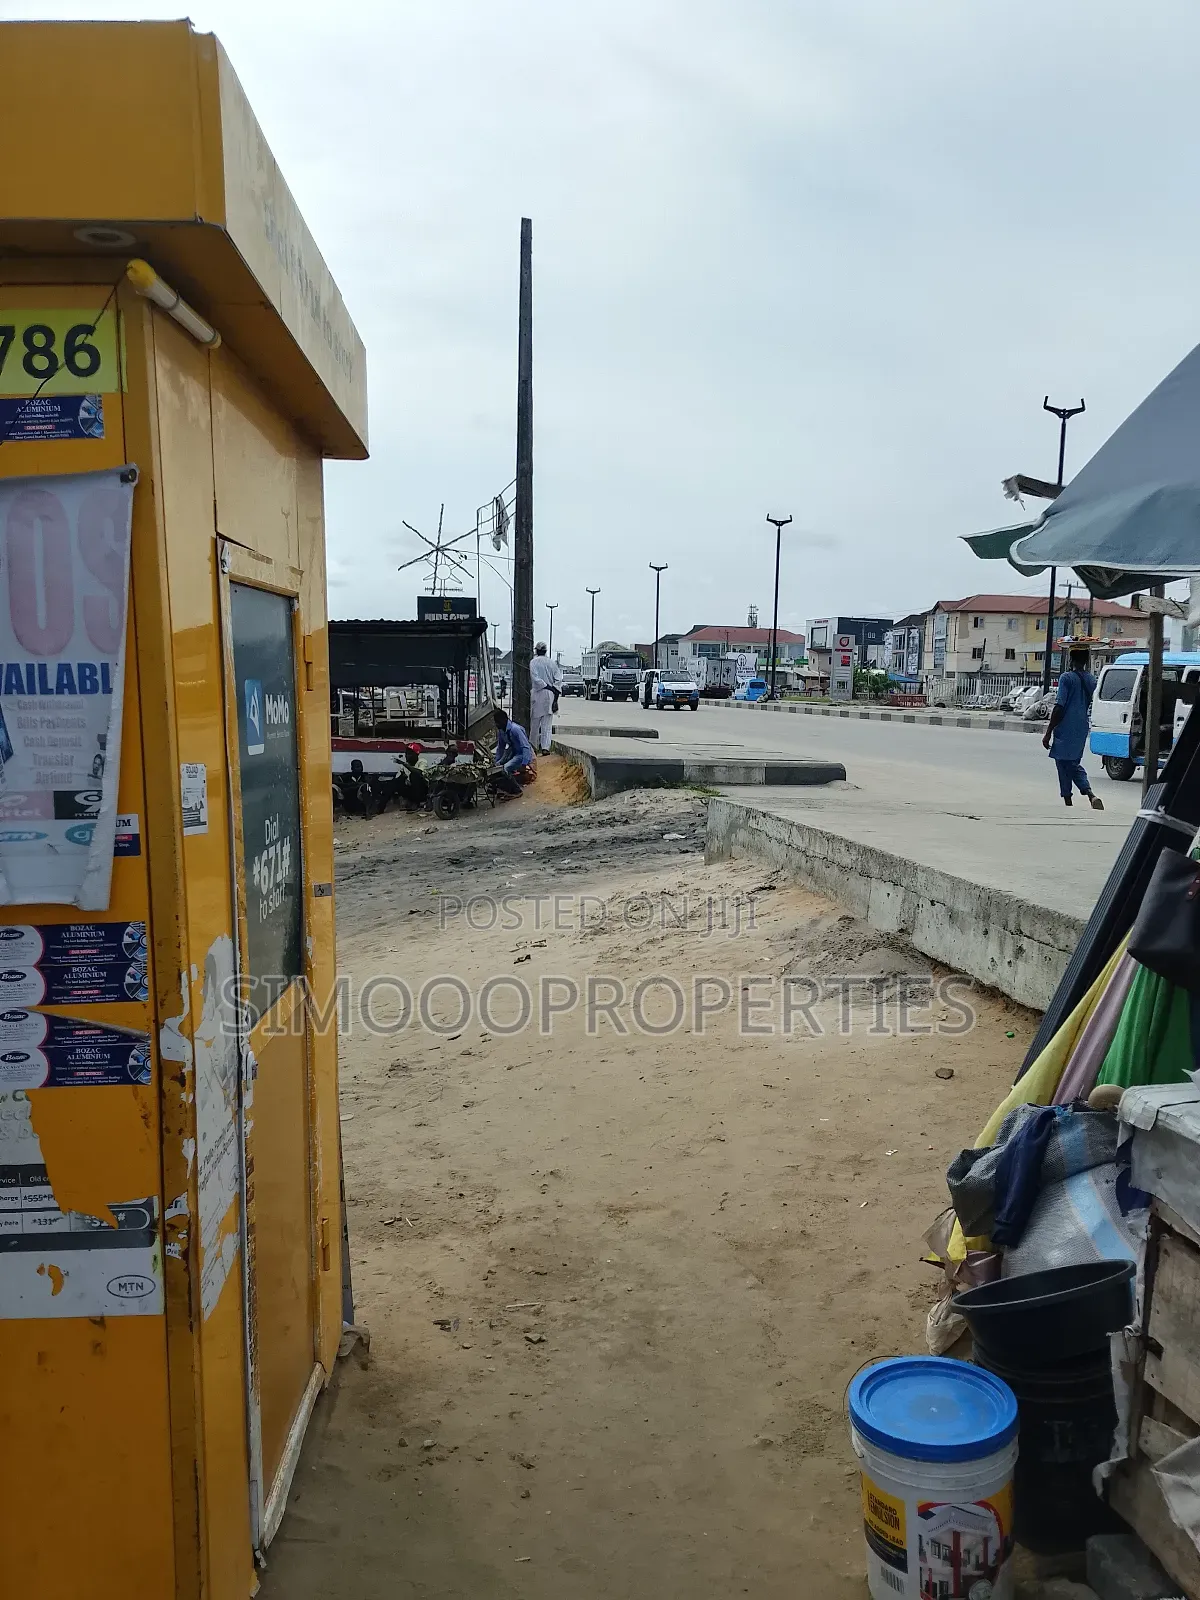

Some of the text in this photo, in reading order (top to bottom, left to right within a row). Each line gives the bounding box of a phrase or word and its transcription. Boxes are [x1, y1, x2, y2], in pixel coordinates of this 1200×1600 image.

[17, 699, 37, 710] Cash
[265, 693, 290, 725] MoMo
[23, 735, 46, 748] Cash
[264, 812, 280, 846] Dial
[259, 897, 268, 924] to
[61, 931, 105, 939] ALUMINIUM
[118, 1282, 144, 1292] MTN
[869, 1493, 898, 1516] STANDARD
[869, 1502, 900, 1531] EMULSION
[889, 1535, 904, 1546] LEAD
